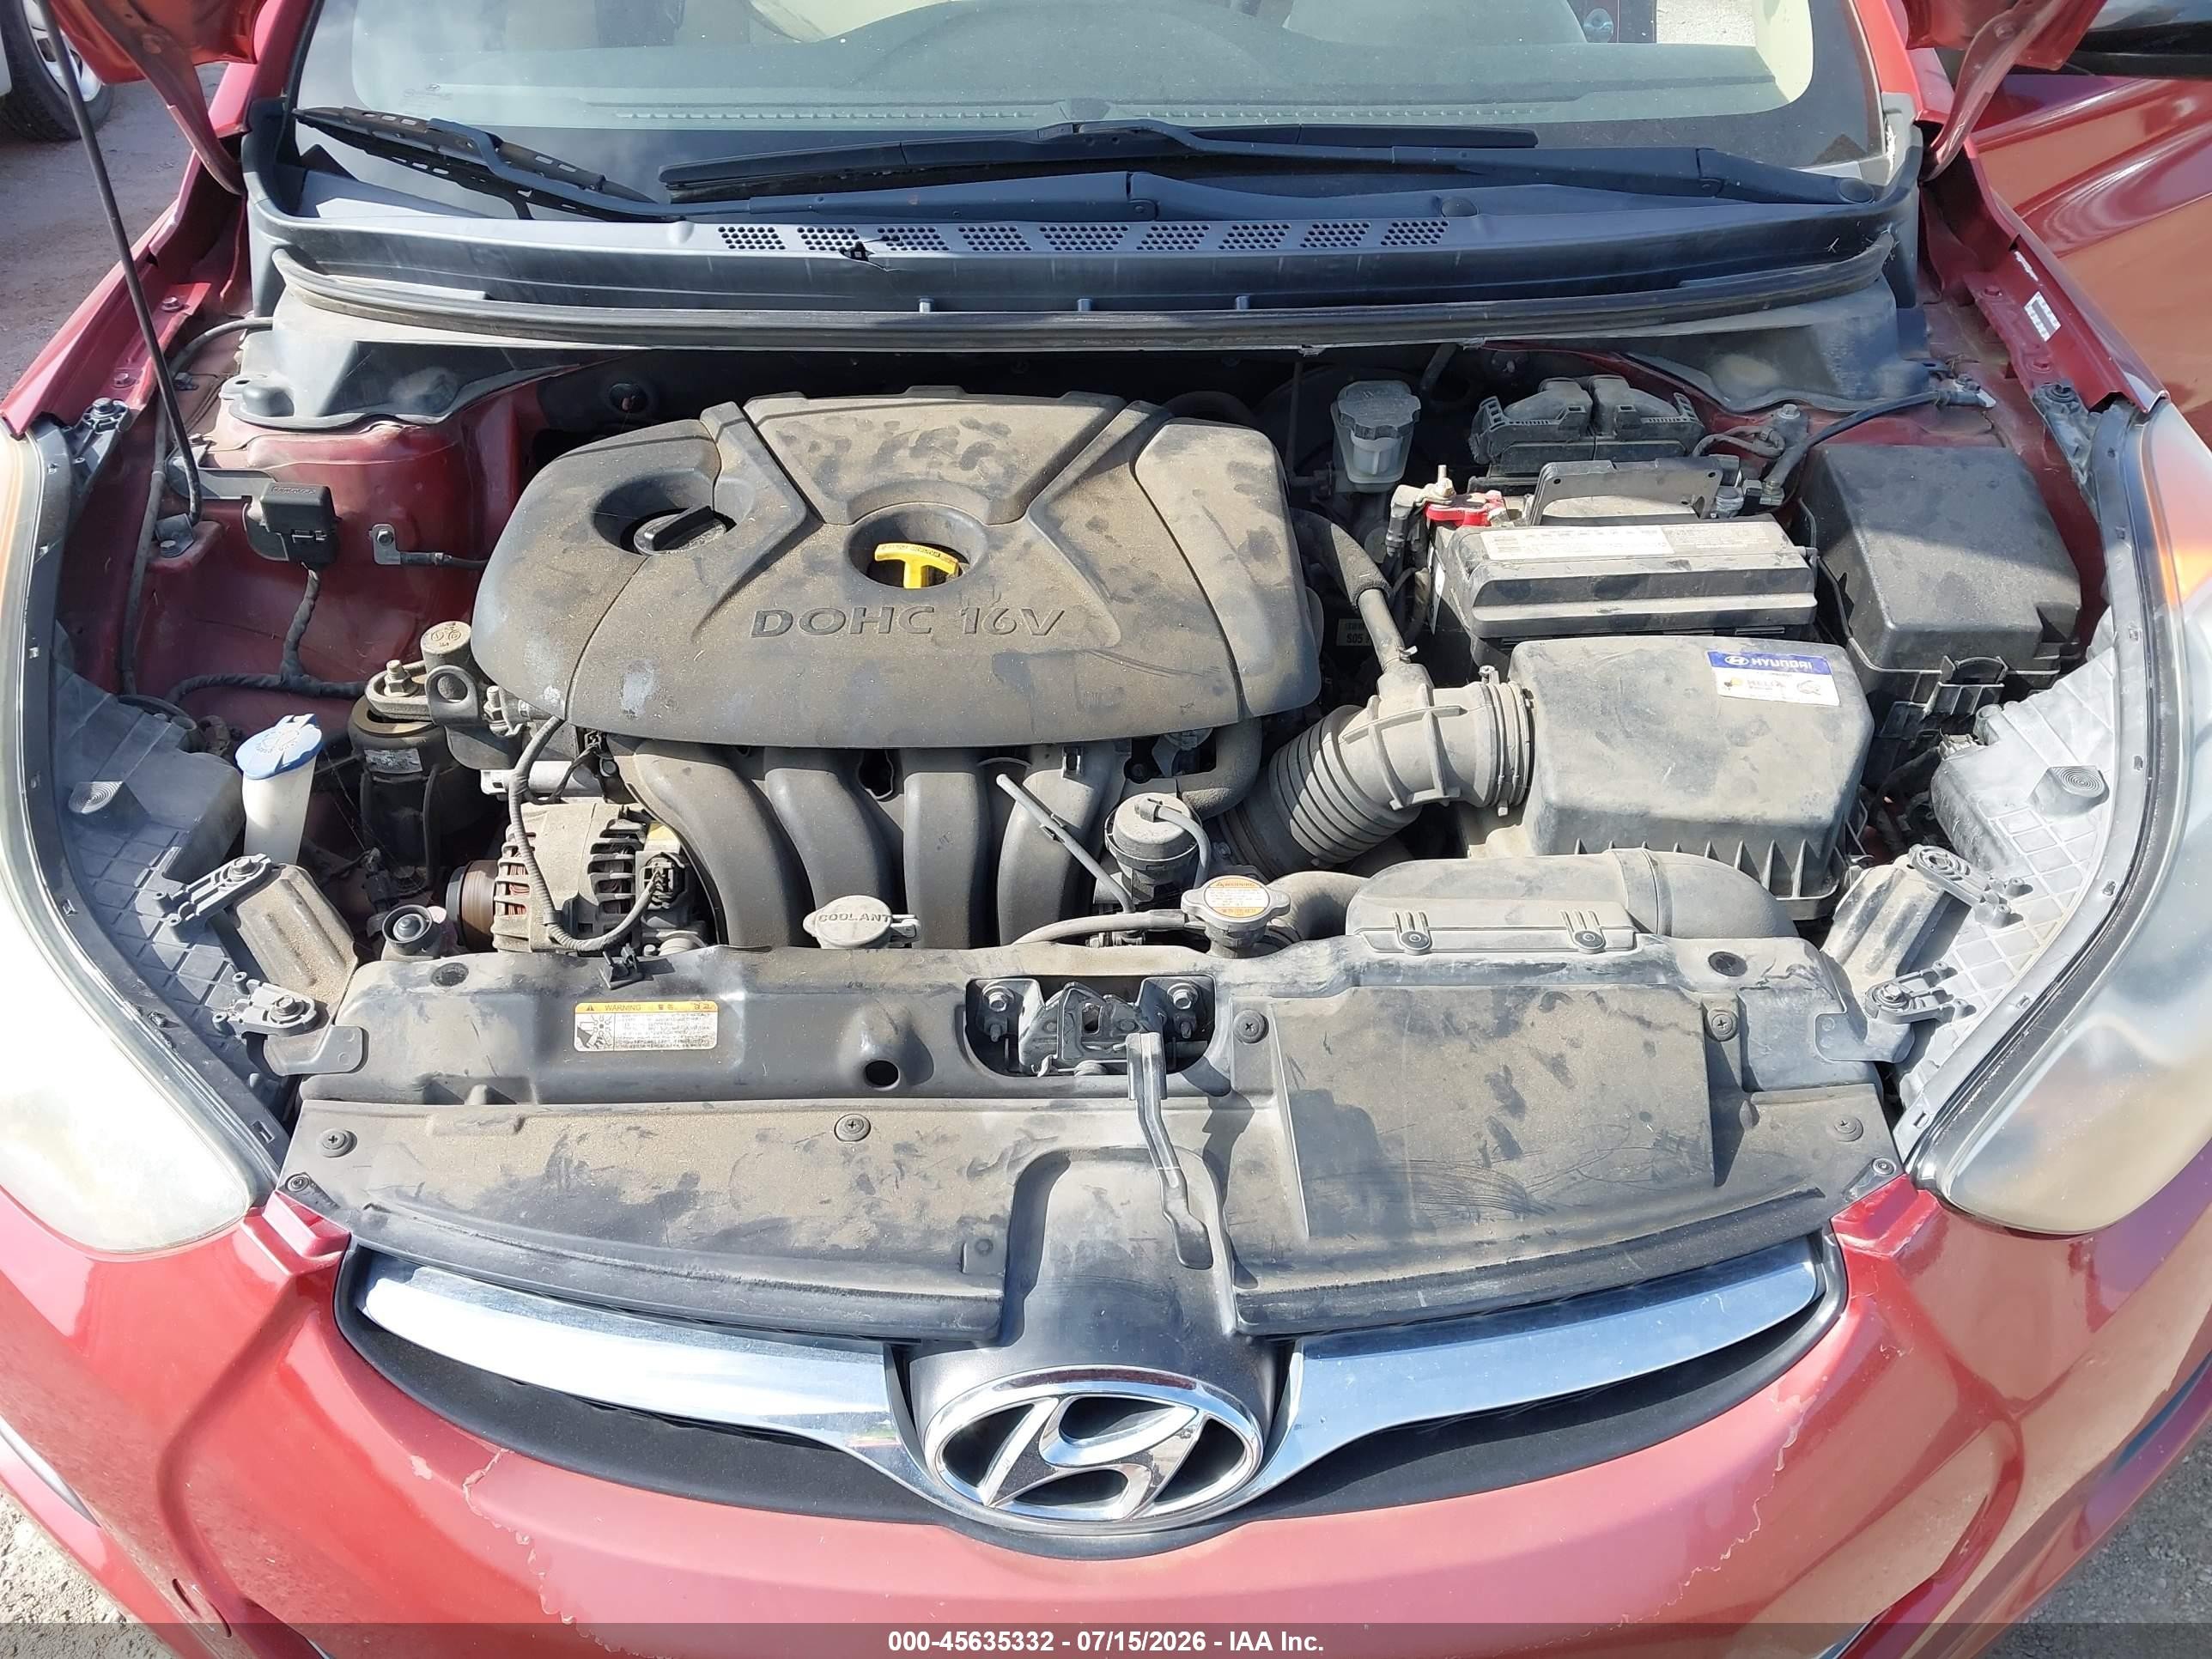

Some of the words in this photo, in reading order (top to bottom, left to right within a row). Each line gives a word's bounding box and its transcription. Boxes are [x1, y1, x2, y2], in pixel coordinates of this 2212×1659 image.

[750, 605, 935, 638] DOHC
[959, 605, 1066, 637] 16V
[1751, 657, 1813, 670] HYUNDAI
[817, 912, 892, 923] COOLANT
